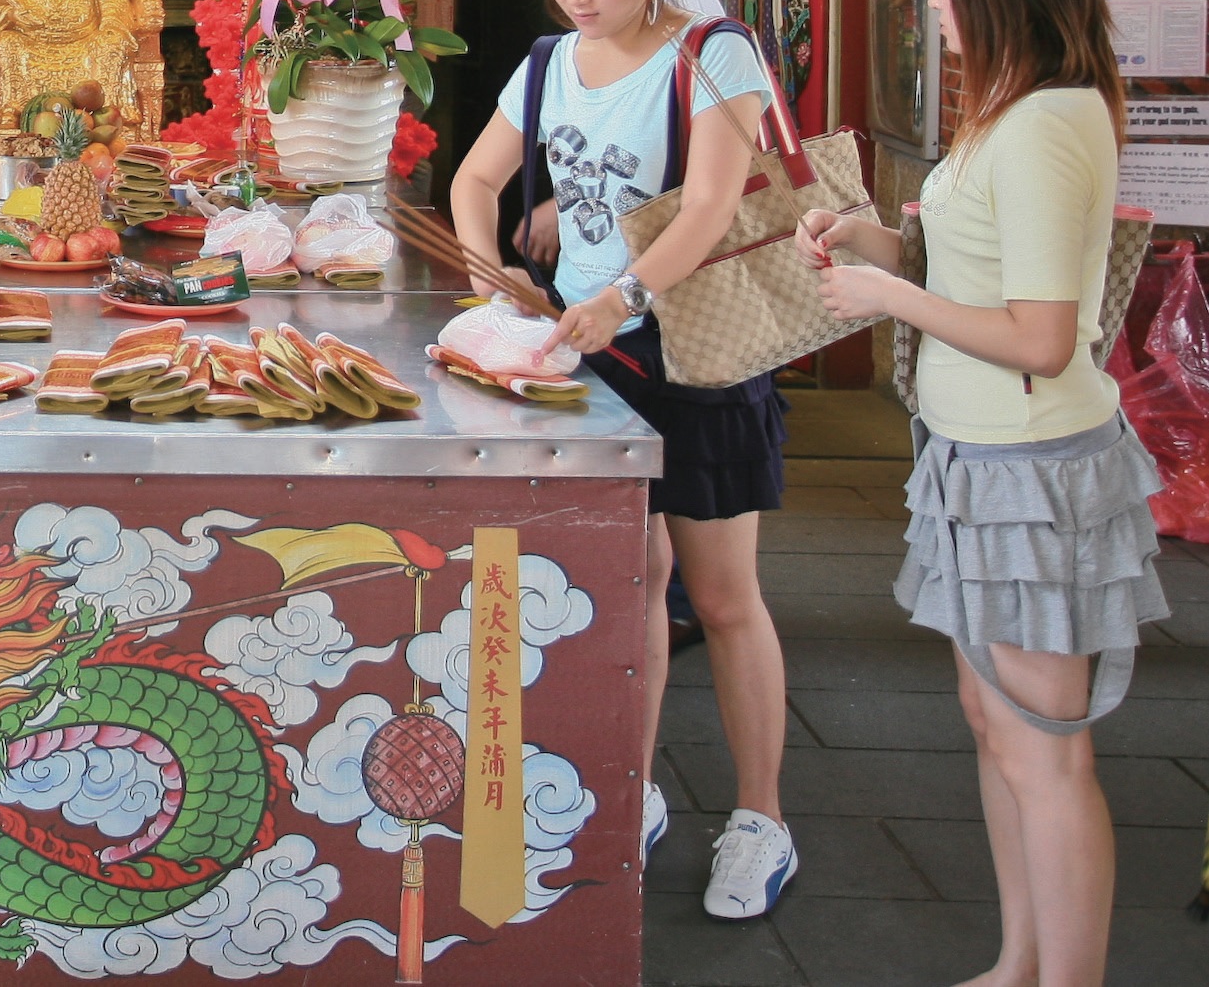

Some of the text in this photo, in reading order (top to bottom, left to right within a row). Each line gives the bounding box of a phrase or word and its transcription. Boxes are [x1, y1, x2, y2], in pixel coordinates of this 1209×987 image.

[184, 280, 202, 294] PAN
[479, 562, 512, 811] 歲次癸未年蒲月
[737, 823, 759, 835] PUMA
